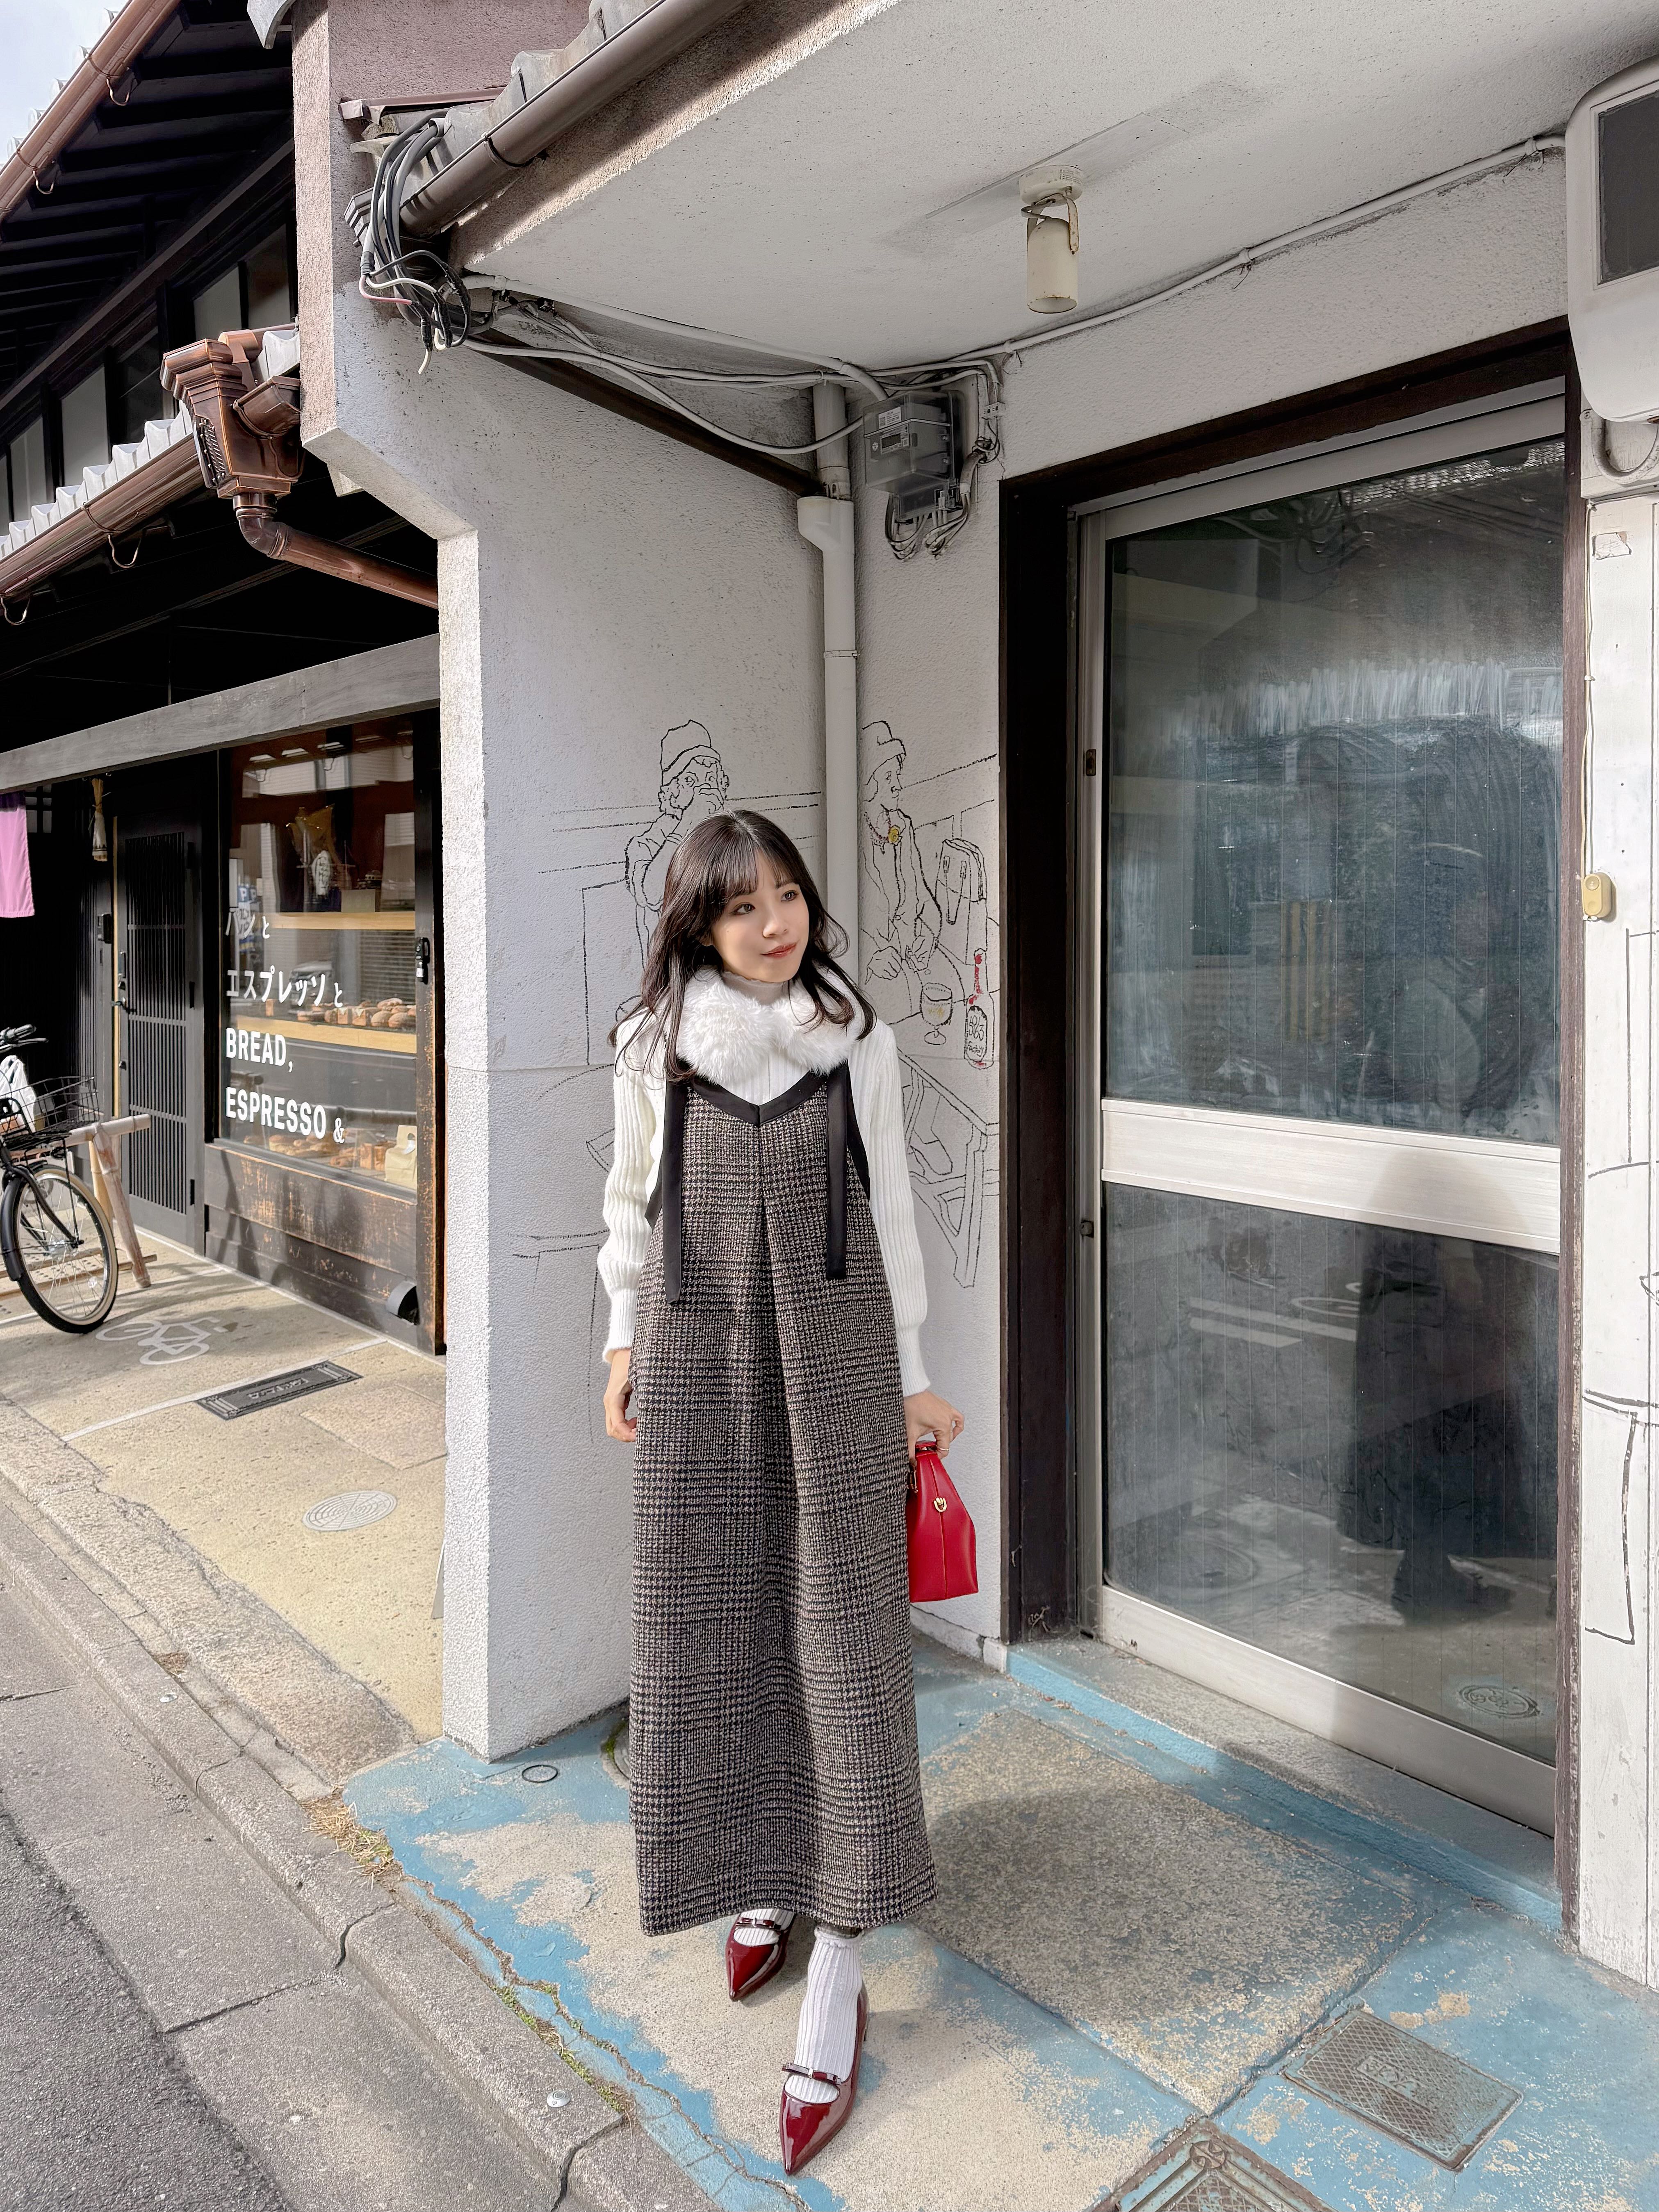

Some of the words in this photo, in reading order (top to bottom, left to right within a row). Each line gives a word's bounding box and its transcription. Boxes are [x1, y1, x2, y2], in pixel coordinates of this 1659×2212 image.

[226, 1027, 293, 1073] BREAD,
[226, 1087, 326, 1139] ESPRESSO
[333, 1117, 345, 1144] &
